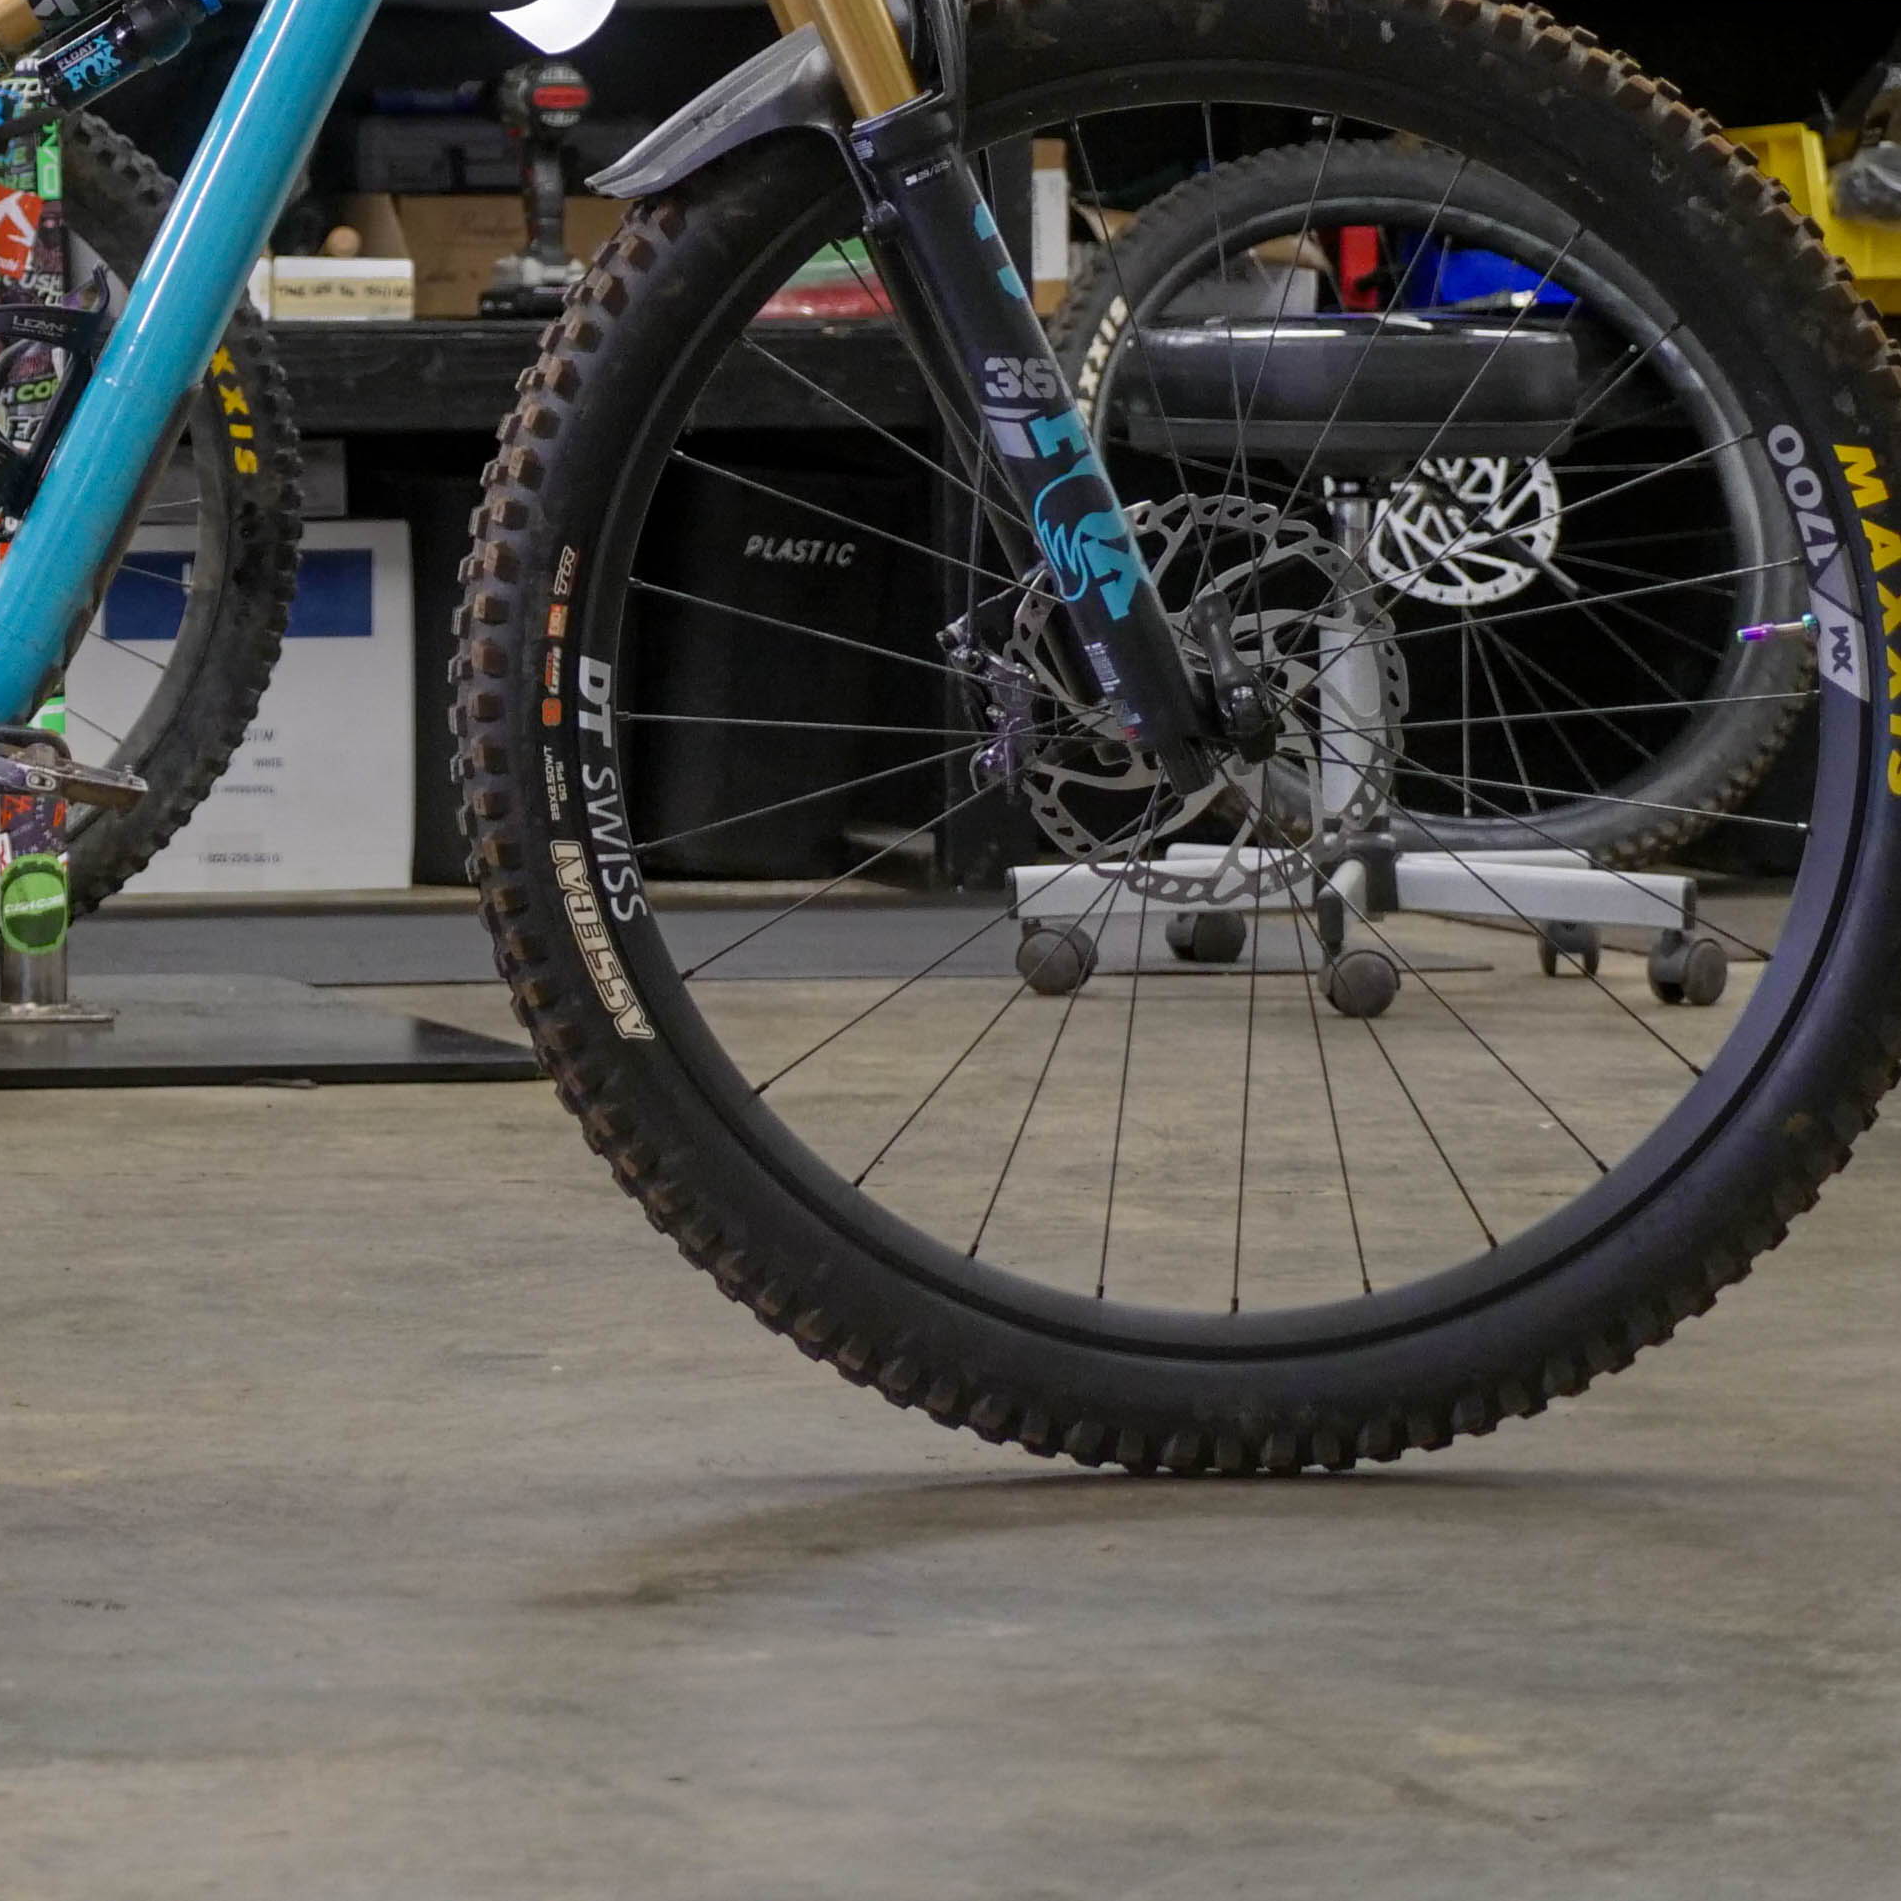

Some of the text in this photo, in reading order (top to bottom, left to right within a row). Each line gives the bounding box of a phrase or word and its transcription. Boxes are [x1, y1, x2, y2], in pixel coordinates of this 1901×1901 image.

[56, 41, 97, 70] FLOAT
[61, 43, 124, 93] FOX
[984, 355, 1059, 401] 36
[210, 345, 258, 474] XXIS
[744, 534, 856, 570] PLASTIC
[578, 655, 649, 923] DT SWISS
[550, 839, 656, 1042] ASSEGAI
